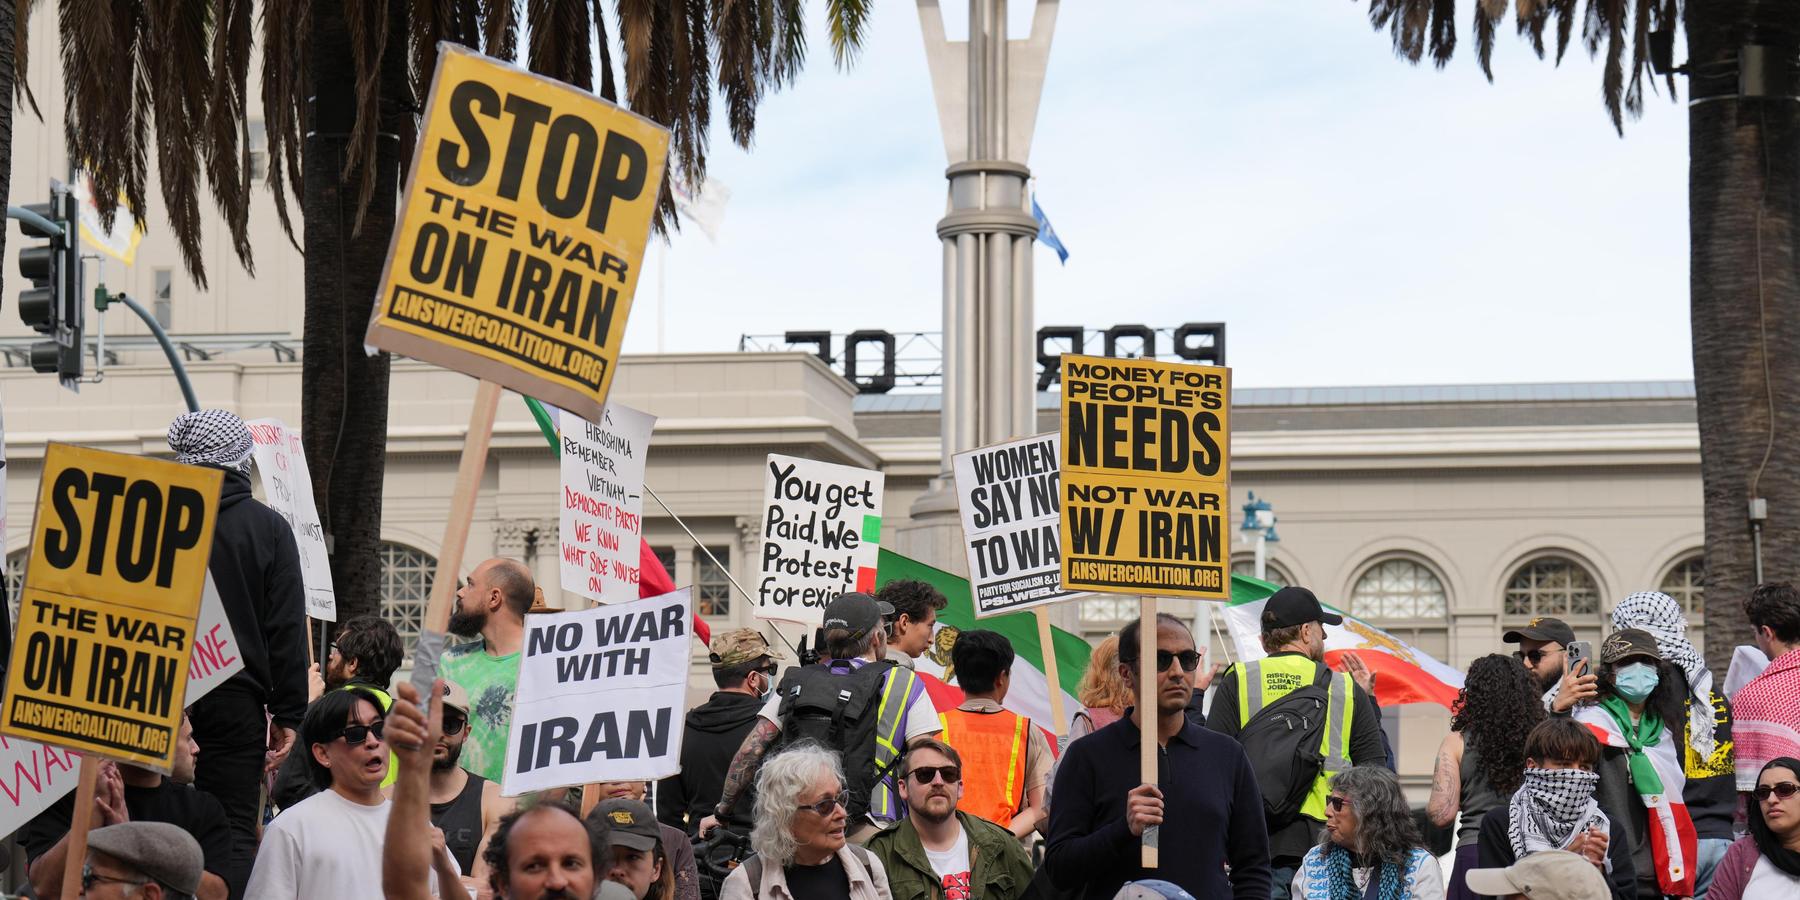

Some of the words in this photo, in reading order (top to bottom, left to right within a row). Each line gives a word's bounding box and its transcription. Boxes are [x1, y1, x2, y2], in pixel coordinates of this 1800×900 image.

[436, 80, 648, 235] STOP
[424, 187, 517, 239] THE
[528, 221, 629, 284] WAR
[409, 221, 488, 298] ON
[496, 248, 618, 349] IRAN
[392, 290, 604, 385] ANSWERCOALITION.ORG
[1068, 363, 1165, 383] MONEY
[1170, 371, 1222, 389] FOR
[1068, 380, 1222, 410] PEOPLE'S
[564, 436, 616, 476] REMEMBER
[586, 422, 632, 459] HIROSHIMA
[971, 440, 1057, 486] WOMEN
[1068, 401, 1221, 477] NEEDS
[565, 485, 612, 520] DEMOCRATIC
[615, 505, 640, 535] PARTY
[769, 460, 822, 505] You
[825, 480, 875, 520] get
[970, 479, 1022, 529] SAY
[1068, 484, 1137, 504] NOT
[1144, 488, 1220, 511] WAR
[44, 467, 205, 589] STOP
[575, 520, 592, 543] WE
[597, 529, 619, 552] KNOW
[821, 520, 860, 550] We
[971, 535, 1009, 579] TO
[1010, 524, 1060, 571] WA
[1068, 506, 1124, 557] W/
[1138, 510, 1221, 563] IRAN
[562, 542, 586, 567] WHAT
[590, 551, 608, 576] SIDE
[612, 559, 640, 585] YOU'RE
[589, 577, 602, 593] ON
[762, 542, 855, 584] Protest
[979, 585, 1000, 598] PARTY
[1000, 583, 1011, 595] FOR
[1011, 577, 1043, 592] SOCIALISM
[1044, 575, 1053, 585] &
[1071, 562, 1220, 588] ANSWERCOALITION.ORG
[758, 576, 800, 607] for
[32, 600, 97, 634] THE
[106, 613, 186, 651] WAR
[527, 622, 584, 658] NO
[595, 603, 685, 648] WAR
[23, 631, 78, 697] ON
[86, 642, 178, 719] IRAN
[556, 647, 651, 684] WITH
[13, 700, 169, 753] ANSWERCOALITION.ORG
[516, 706, 672, 774] IRAN
